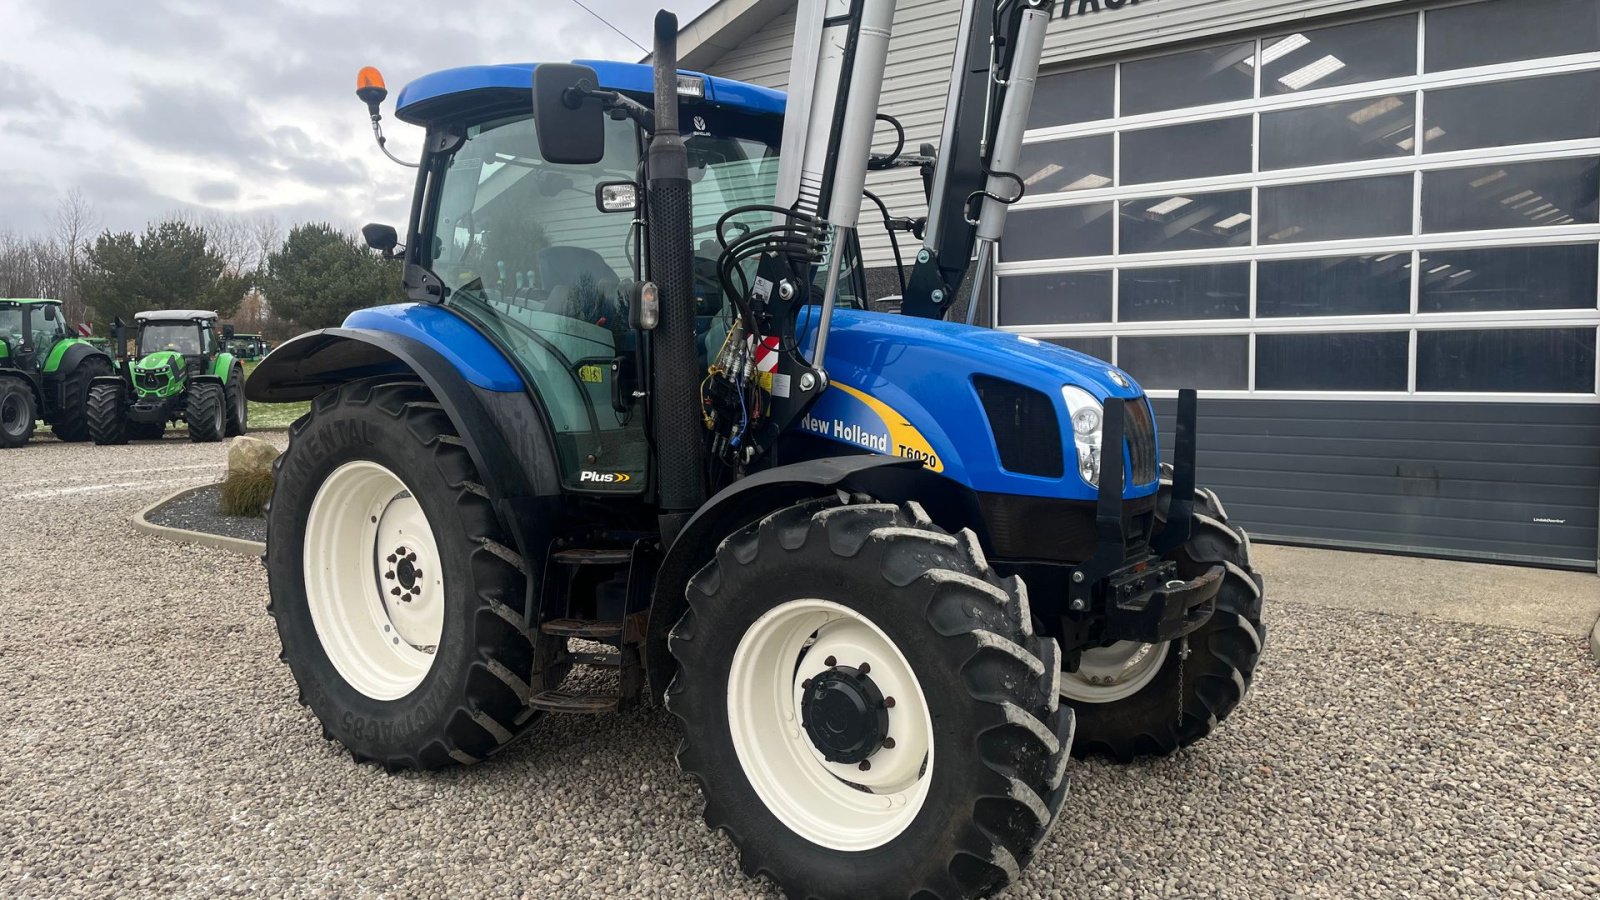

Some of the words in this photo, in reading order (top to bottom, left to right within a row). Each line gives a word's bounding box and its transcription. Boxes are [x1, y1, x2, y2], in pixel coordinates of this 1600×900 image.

[801, 412, 829, 434] New
[834, 419, 887, 451] Holland
[899, 445, 936, 468] T6020
[580, 471, 614, 482] Plus
